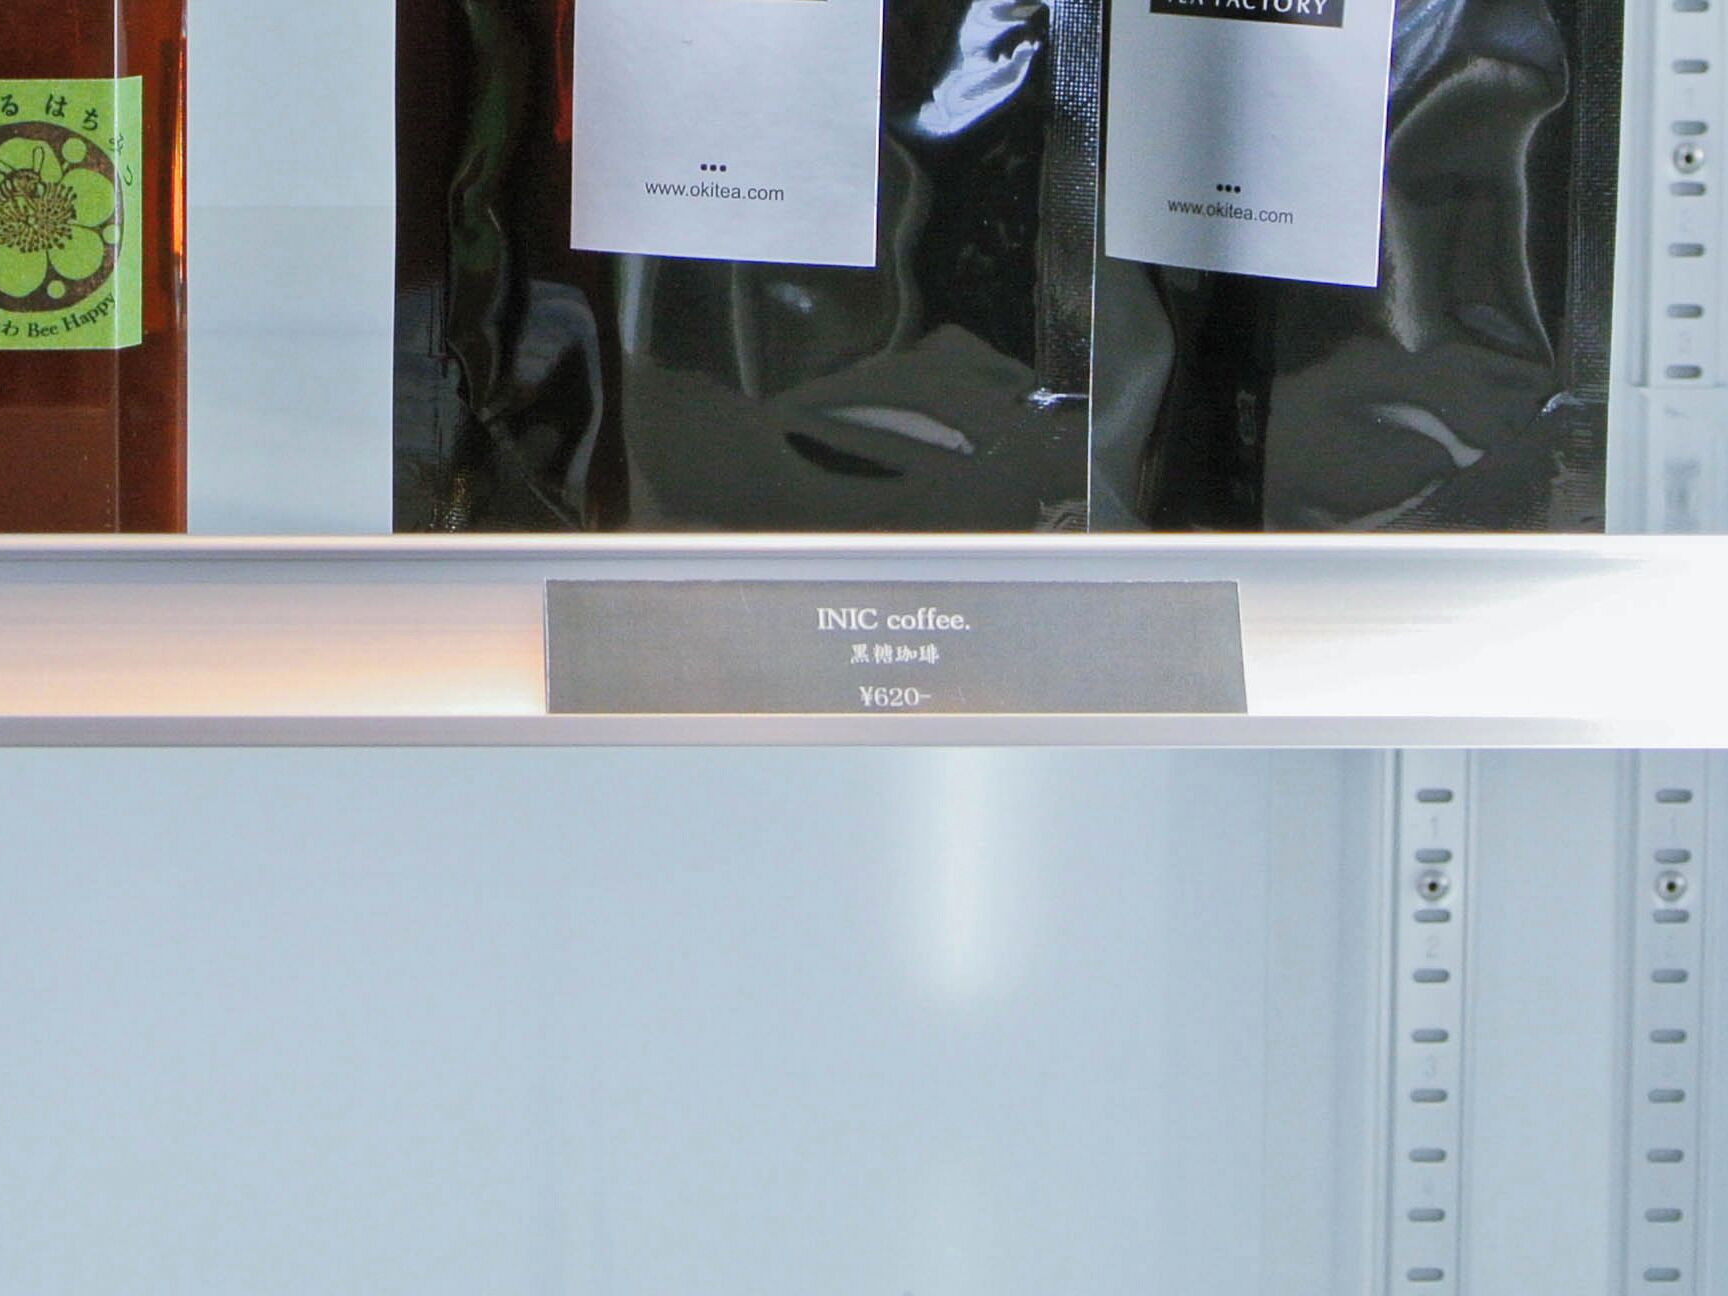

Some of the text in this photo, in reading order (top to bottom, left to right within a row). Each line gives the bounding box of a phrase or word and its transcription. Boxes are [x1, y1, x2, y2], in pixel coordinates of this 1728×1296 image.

[645, 182, 784, 200] www.okitea.com
[1167, 200, 1294, 224] www.okitea.com
[27, 322, 59, 338] Bee
[63, 291, 117, 332] Happy
[816, 607, 971, 630] INIC coffee.
[859, 686, 932, 707] ¥620-
